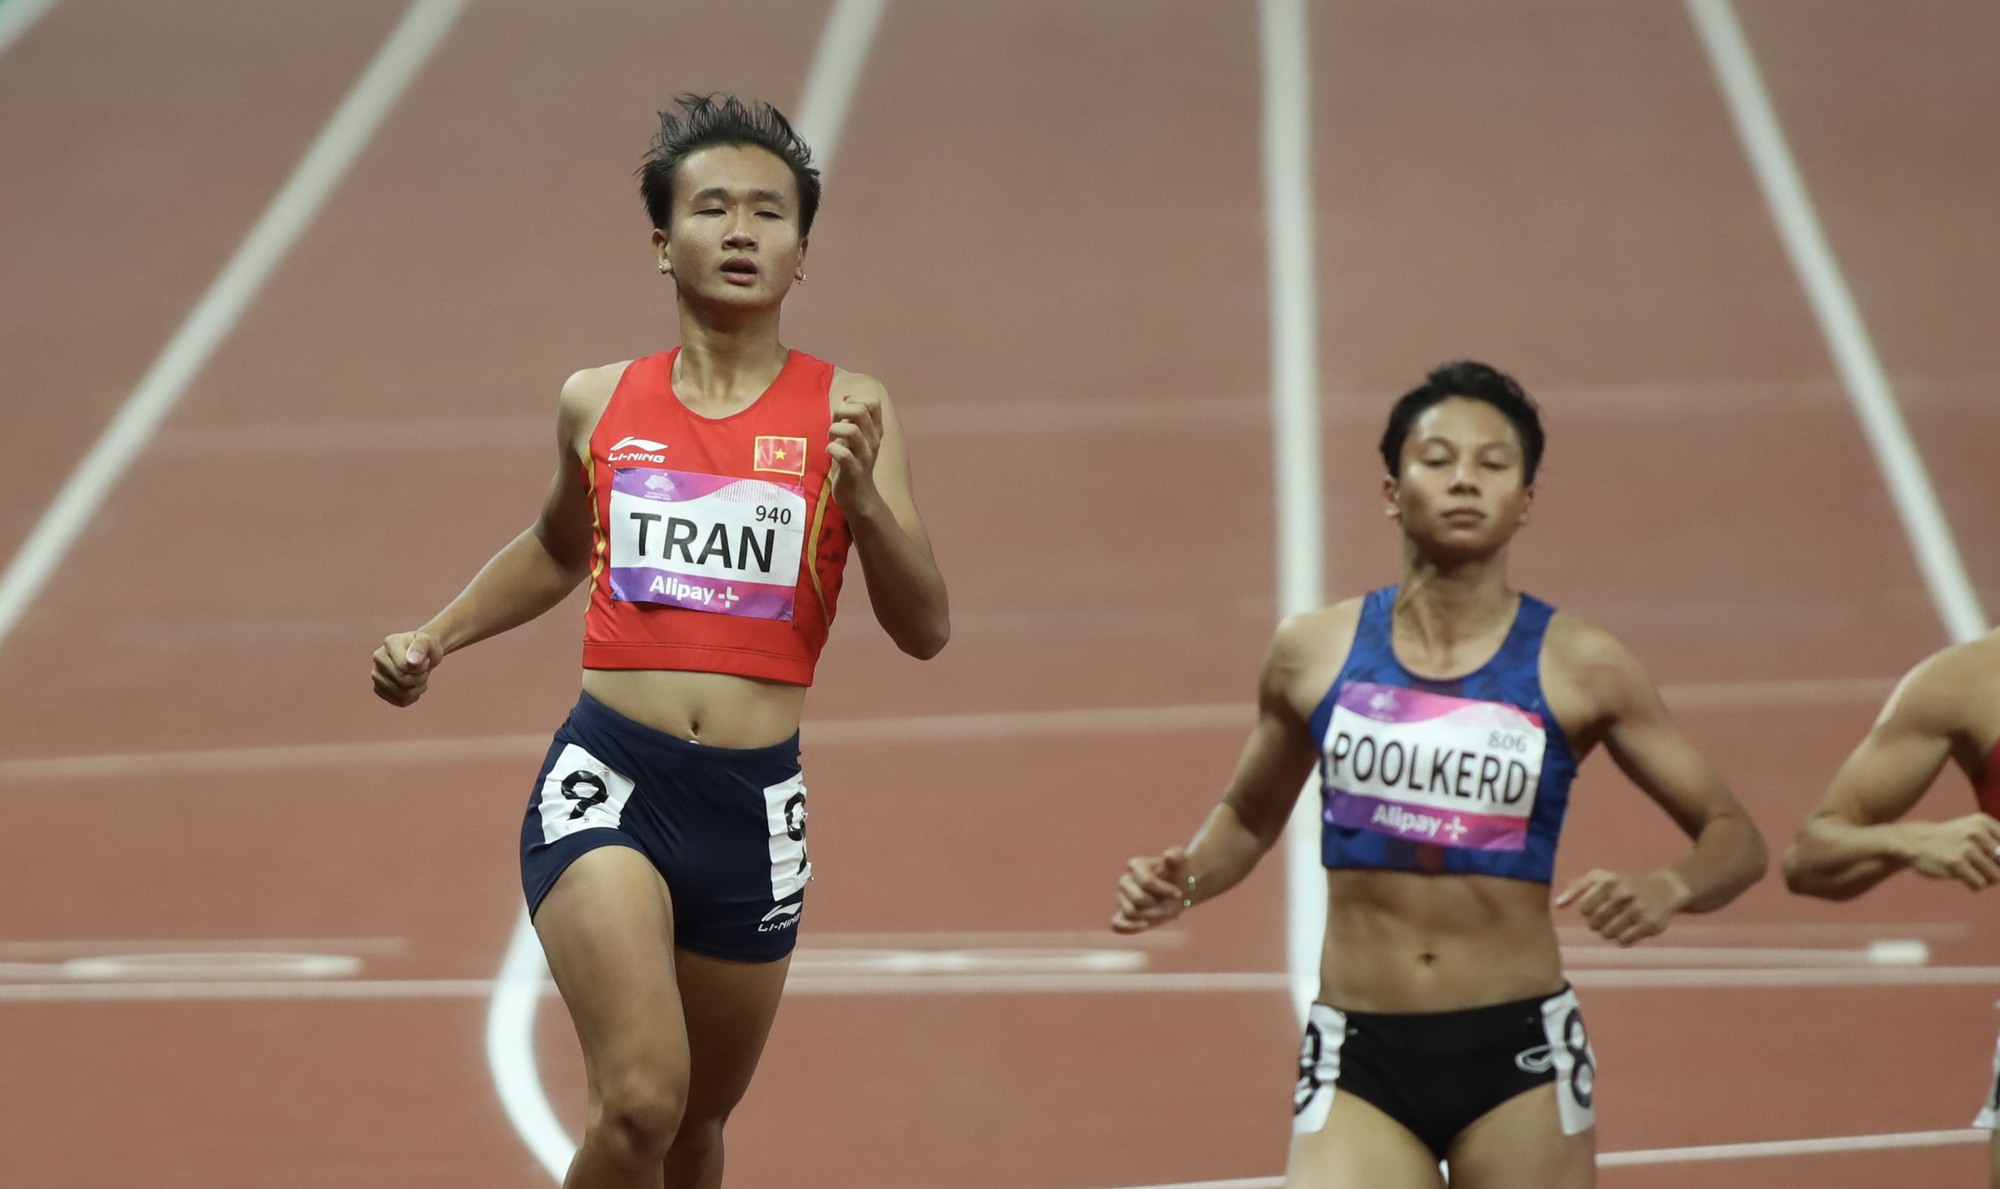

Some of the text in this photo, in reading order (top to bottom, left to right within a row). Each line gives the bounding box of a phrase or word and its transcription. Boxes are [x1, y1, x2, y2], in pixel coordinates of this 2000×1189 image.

[608, 453, 665, 463] LI-NING
[755, 505, 791, 525] 940
[630, 512, 775, 573] TRAN
[1487, 730, 1527, 753] 806
[1331, 732, 1527, 804] POOLKERD
[560, 769, 609, 820] 9
[1565, 1008, 1594, 1109] 8
